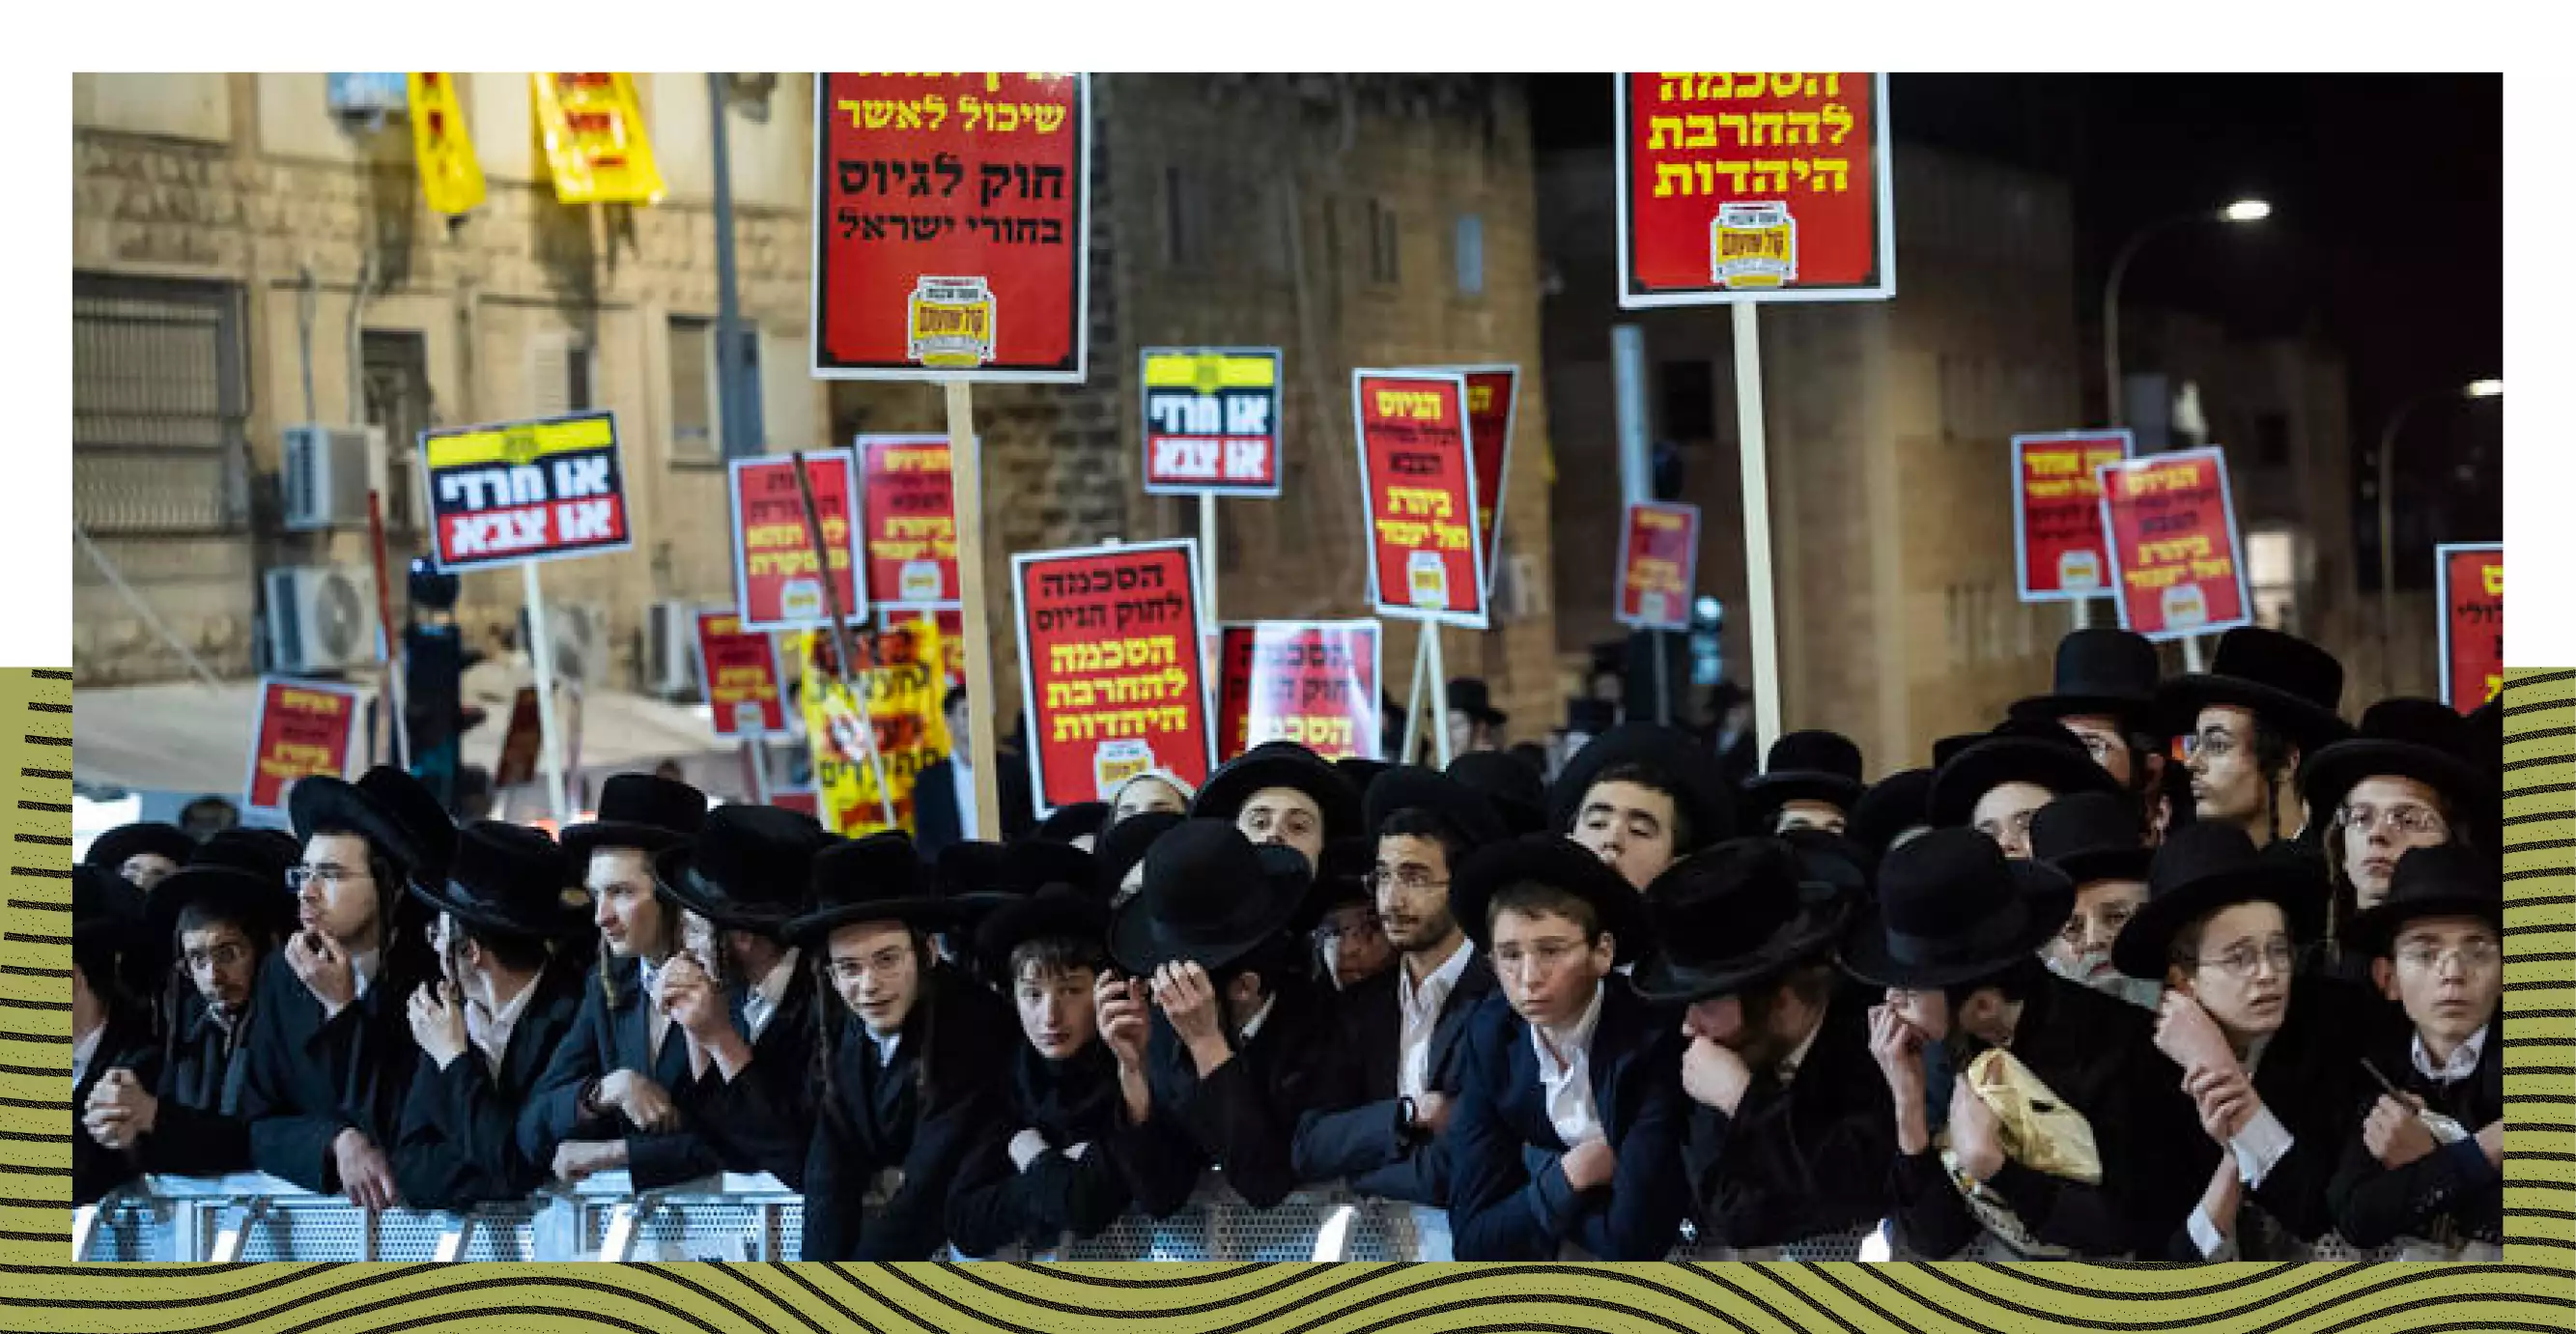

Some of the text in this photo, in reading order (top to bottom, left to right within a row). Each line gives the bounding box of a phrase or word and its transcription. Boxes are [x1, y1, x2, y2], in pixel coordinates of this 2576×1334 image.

[1660, 72, 1840, 101] הסכמה
[838, 94, 1066, 133] שיכול לאשר
[1648, 102, 1854, 150] להחרבת
[838, 152, 1065, 207] חוק לגיוס
[1654, 157, 1849, 198] היהדות
[838, 207, 1062, 243] בחורי ישראל
[1150, 394, 1270, 434] או חרדי
[1153, 438, 1267, 479] או צבא
[440, 456, 609, 511] או חרדי
[452, 499, 612, 557] או צבא
[1040, 563, 1165, 599] הסכמה
[1035, 589, 1184, 633] לחוק הגיוס
[1050, 634, 1177, 673] הסכמה
[1046, 667, 1189, 709] להחרבת
[1053, 704, 1189, 742] היהדות
